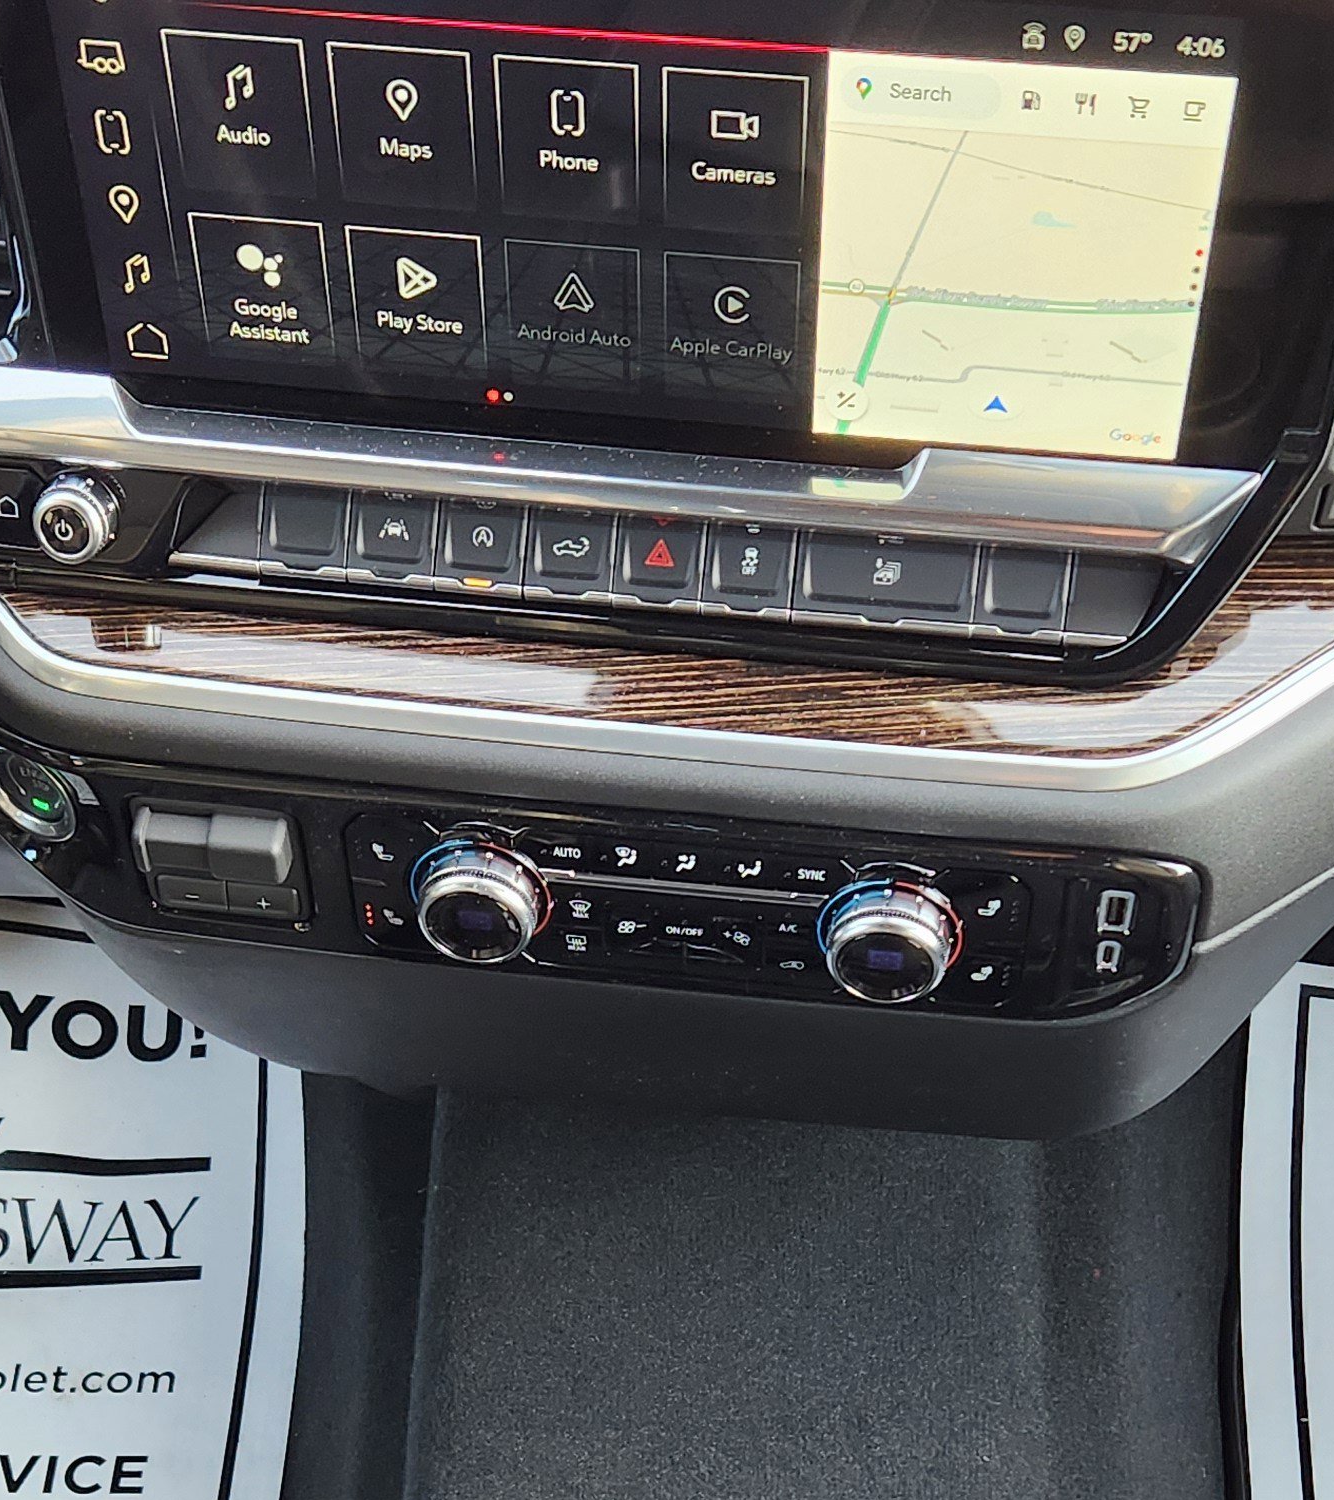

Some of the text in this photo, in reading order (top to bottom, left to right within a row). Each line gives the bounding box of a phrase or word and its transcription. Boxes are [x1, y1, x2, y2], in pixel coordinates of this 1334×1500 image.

[1176, 35, 1226, 59] 4:06
[889, 82, 952, 104] Search
[216, 124, 271, 149] Audio
[379, 137, 433, 163] Maps
[539, 150, 600, 176] Phone
[691, 161, 777, 187] Cameras
[234, 299, 299, 324] Google
[376, 310, 464, 337] Play Store
[228, 320, 310, 346] Assistant
[516, 323, 632, 350] Android Auto
[669, 337, 794, 364] Apple CarPlay
[1109, 428, 1161, 446] Google
[741, 566, 757, 576] OFF
[553, 847, 581, 859] AUTO
[797, 868, 826, 882] SYNC
[665, 926, 704, 937] ON/OFF
[779, 923, 798, 934] A/C
